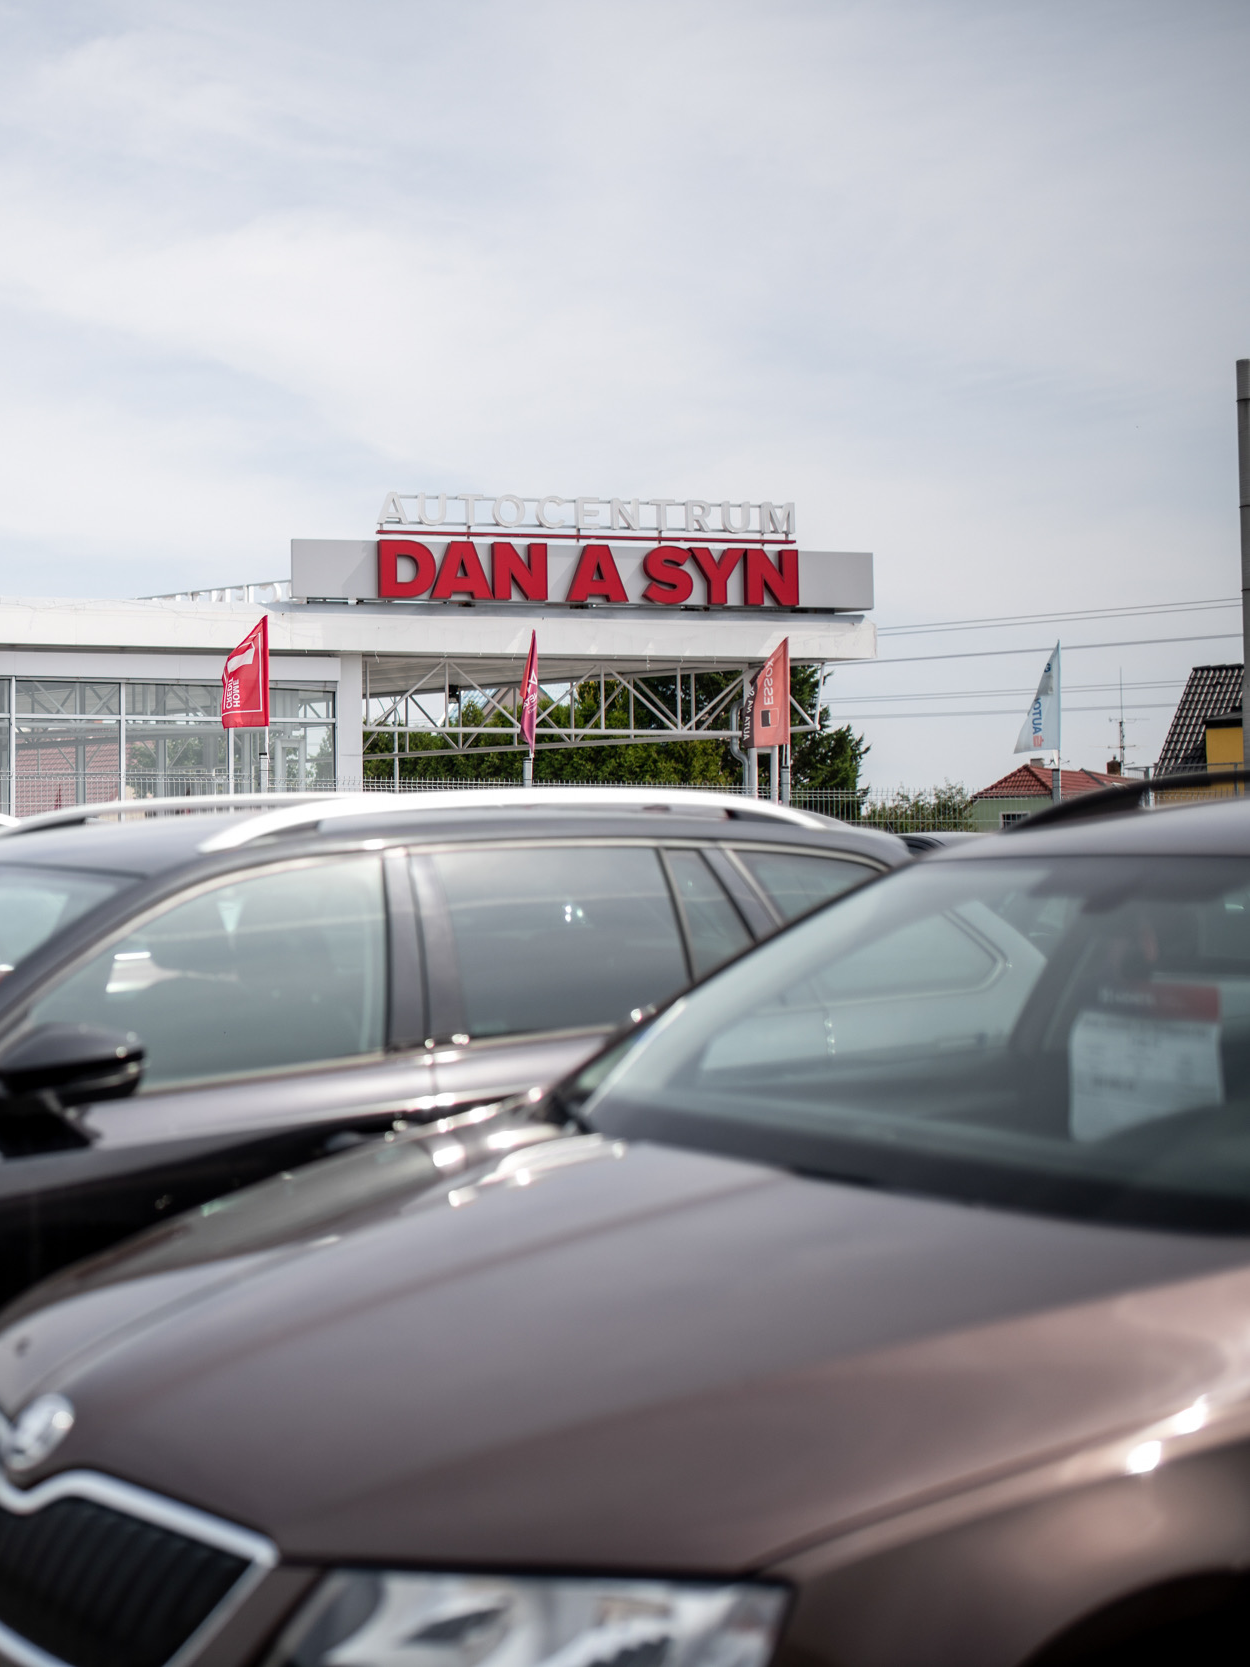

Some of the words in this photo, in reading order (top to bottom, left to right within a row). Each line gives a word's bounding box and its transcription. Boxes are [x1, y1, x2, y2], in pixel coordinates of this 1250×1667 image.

[377, 491, 796, 535] AUTOCENTRUM
[377, 539, 548, 600] DAN
[565, 544, 629, 602] A
[642, 545, 799, 606] SYN
